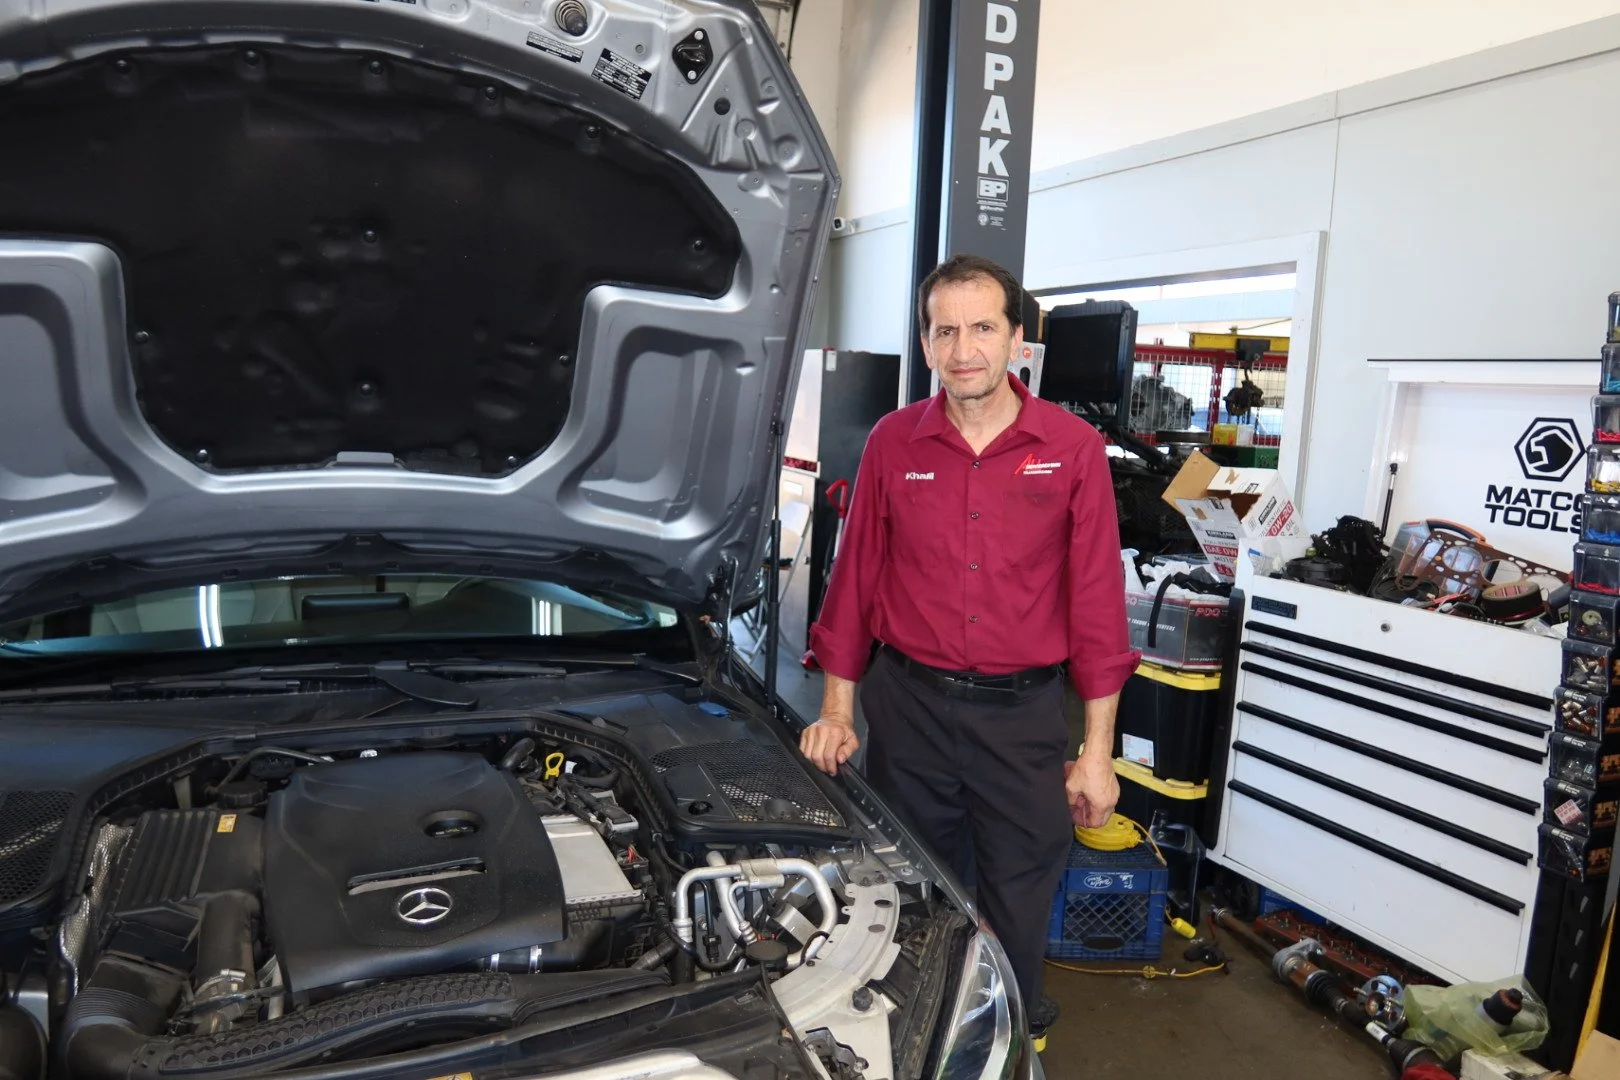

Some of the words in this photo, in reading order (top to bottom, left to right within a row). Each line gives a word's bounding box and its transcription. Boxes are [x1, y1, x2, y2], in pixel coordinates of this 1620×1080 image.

[978, 0, 1018, 177] DPAK
[980, 180, 1007, 198] BP
[1222, 547, 1238, 557] 0W
[1194, 607, 1221, 617] PDQ
